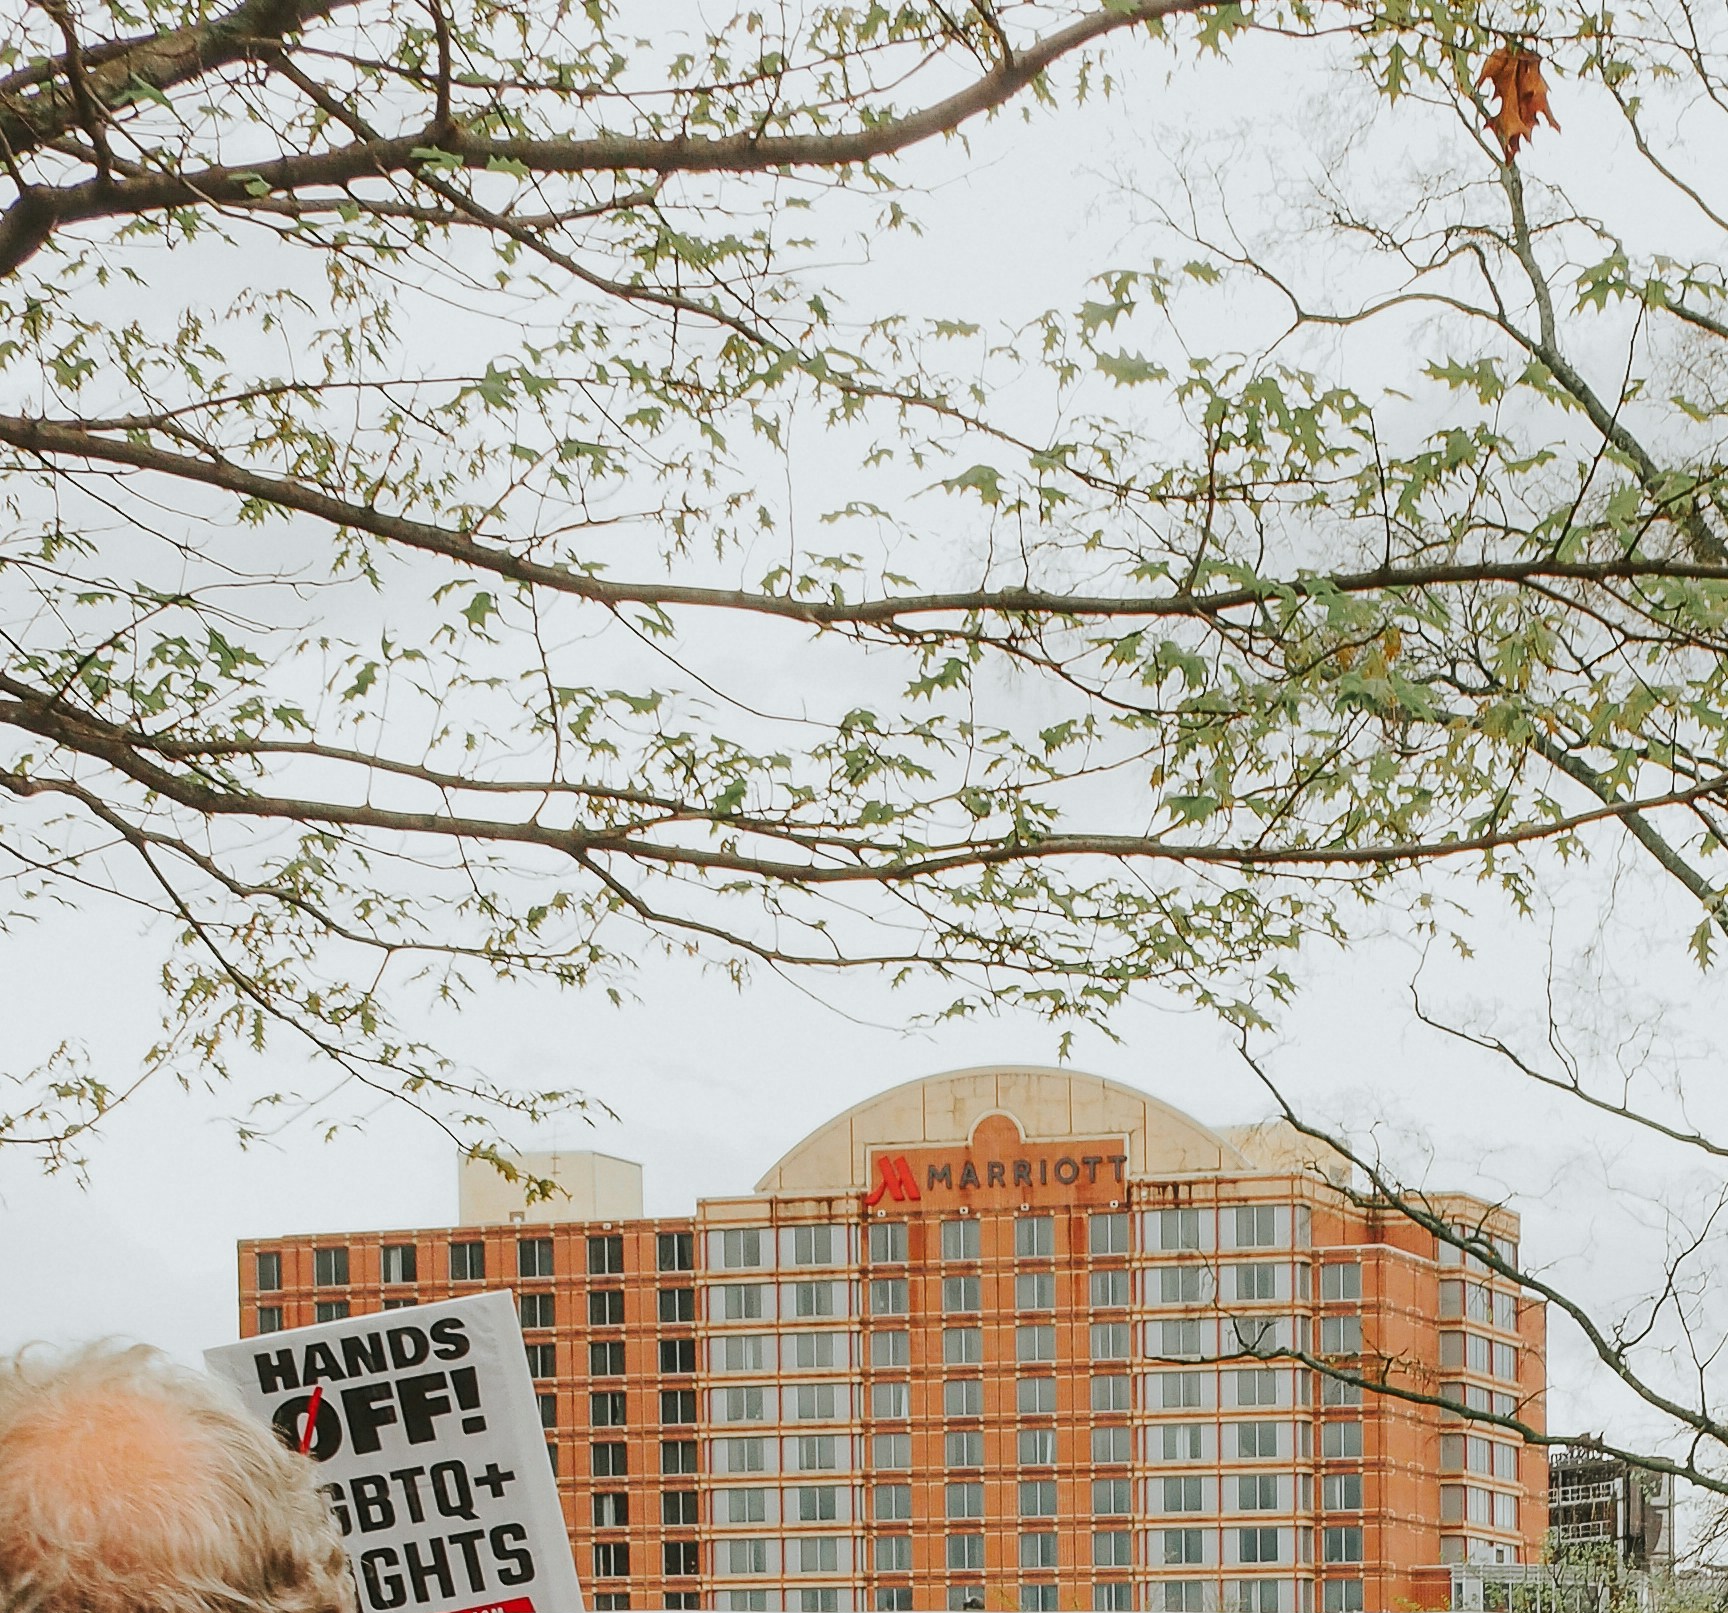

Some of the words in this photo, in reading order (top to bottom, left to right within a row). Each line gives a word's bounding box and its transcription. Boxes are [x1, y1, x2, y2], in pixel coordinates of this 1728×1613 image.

[927, 1154, 1128, 1191] MARRIOTT
[253, 1317, 471, 1395] HANDS
[271, 1365, 487, 1463] OFF!
[317, 1459, 516, 1537] GBTQ+
